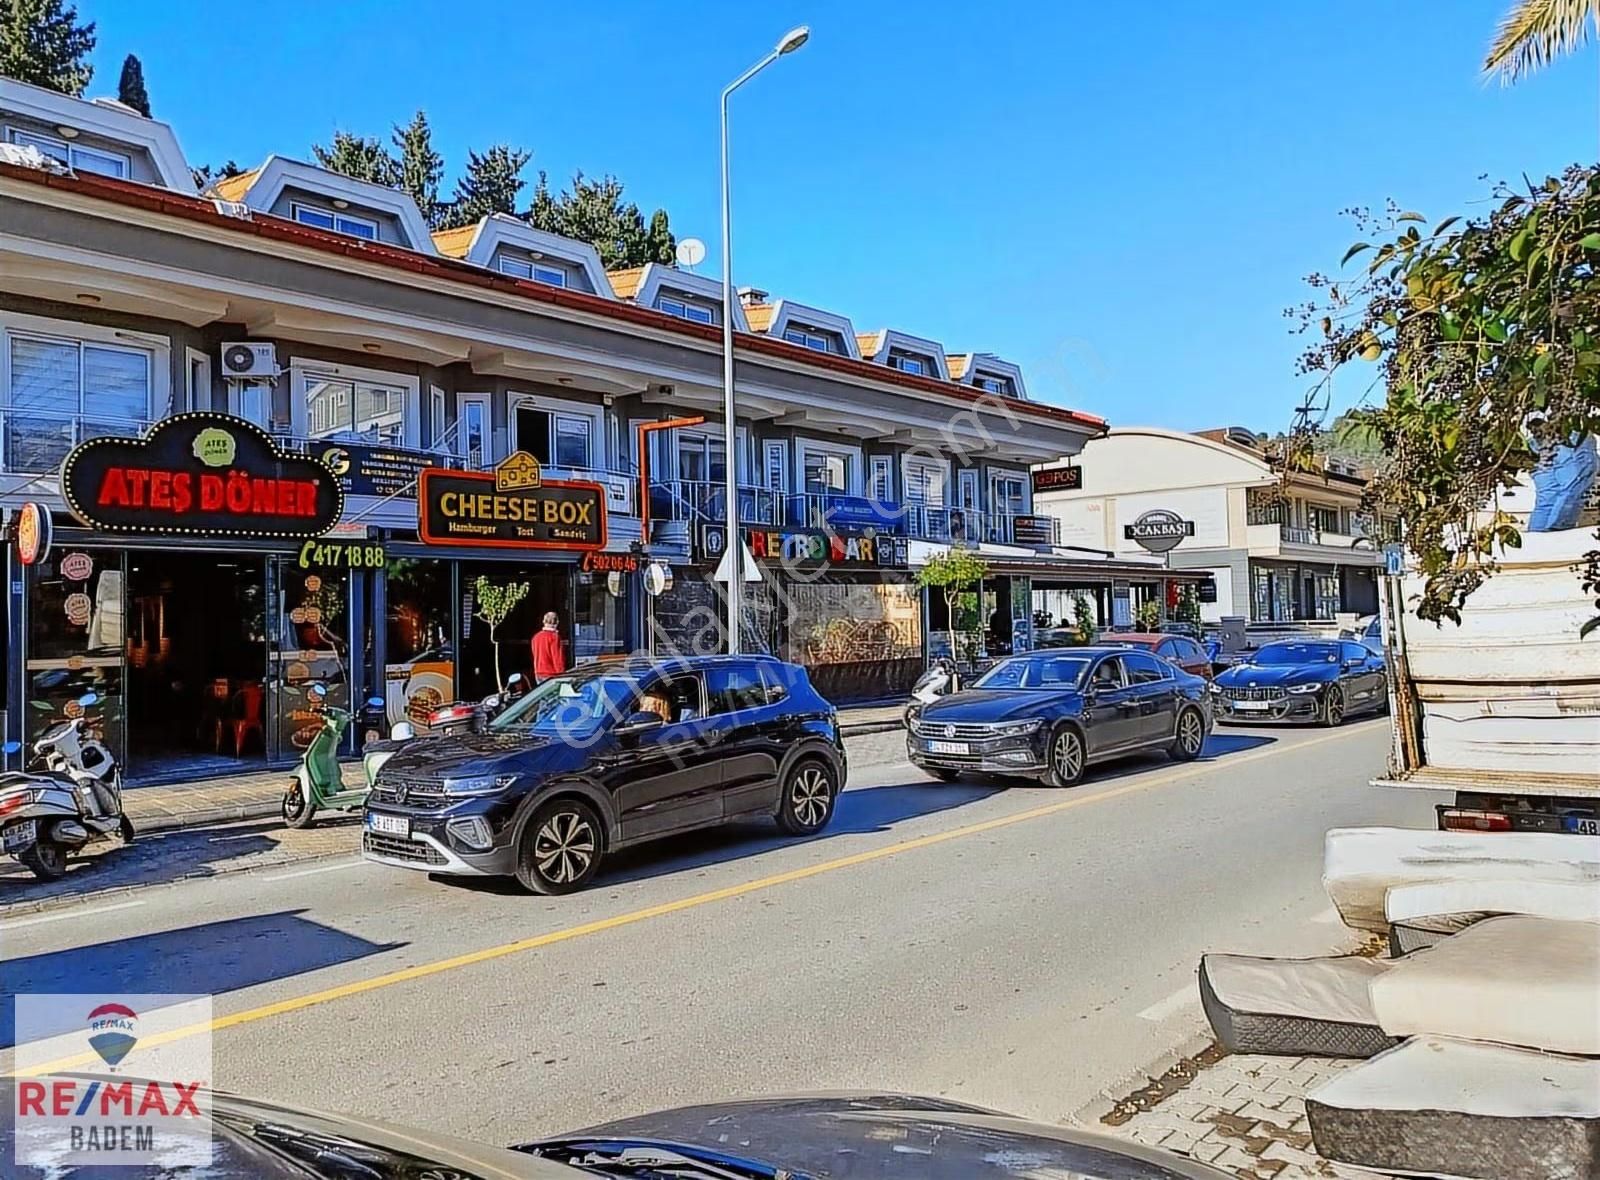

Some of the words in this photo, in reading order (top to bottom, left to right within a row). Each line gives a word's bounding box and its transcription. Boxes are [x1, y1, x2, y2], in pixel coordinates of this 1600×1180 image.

[98, 467, 192, 514] ATEŞ
[200, 470, 318, 518] DÖNER
[440, 492, 537, 522] CHEESE
[544, 500, 592, 526] BOX
[448, 521, 497, 535] Hamburger
[312, 543, 342, 566] 417
[345, 545, 361, 567] 18
[364, 546, 384, 569] 88
[751, 530, 827, 561] RETRO
[1579, 820, 1597, 835] 48
